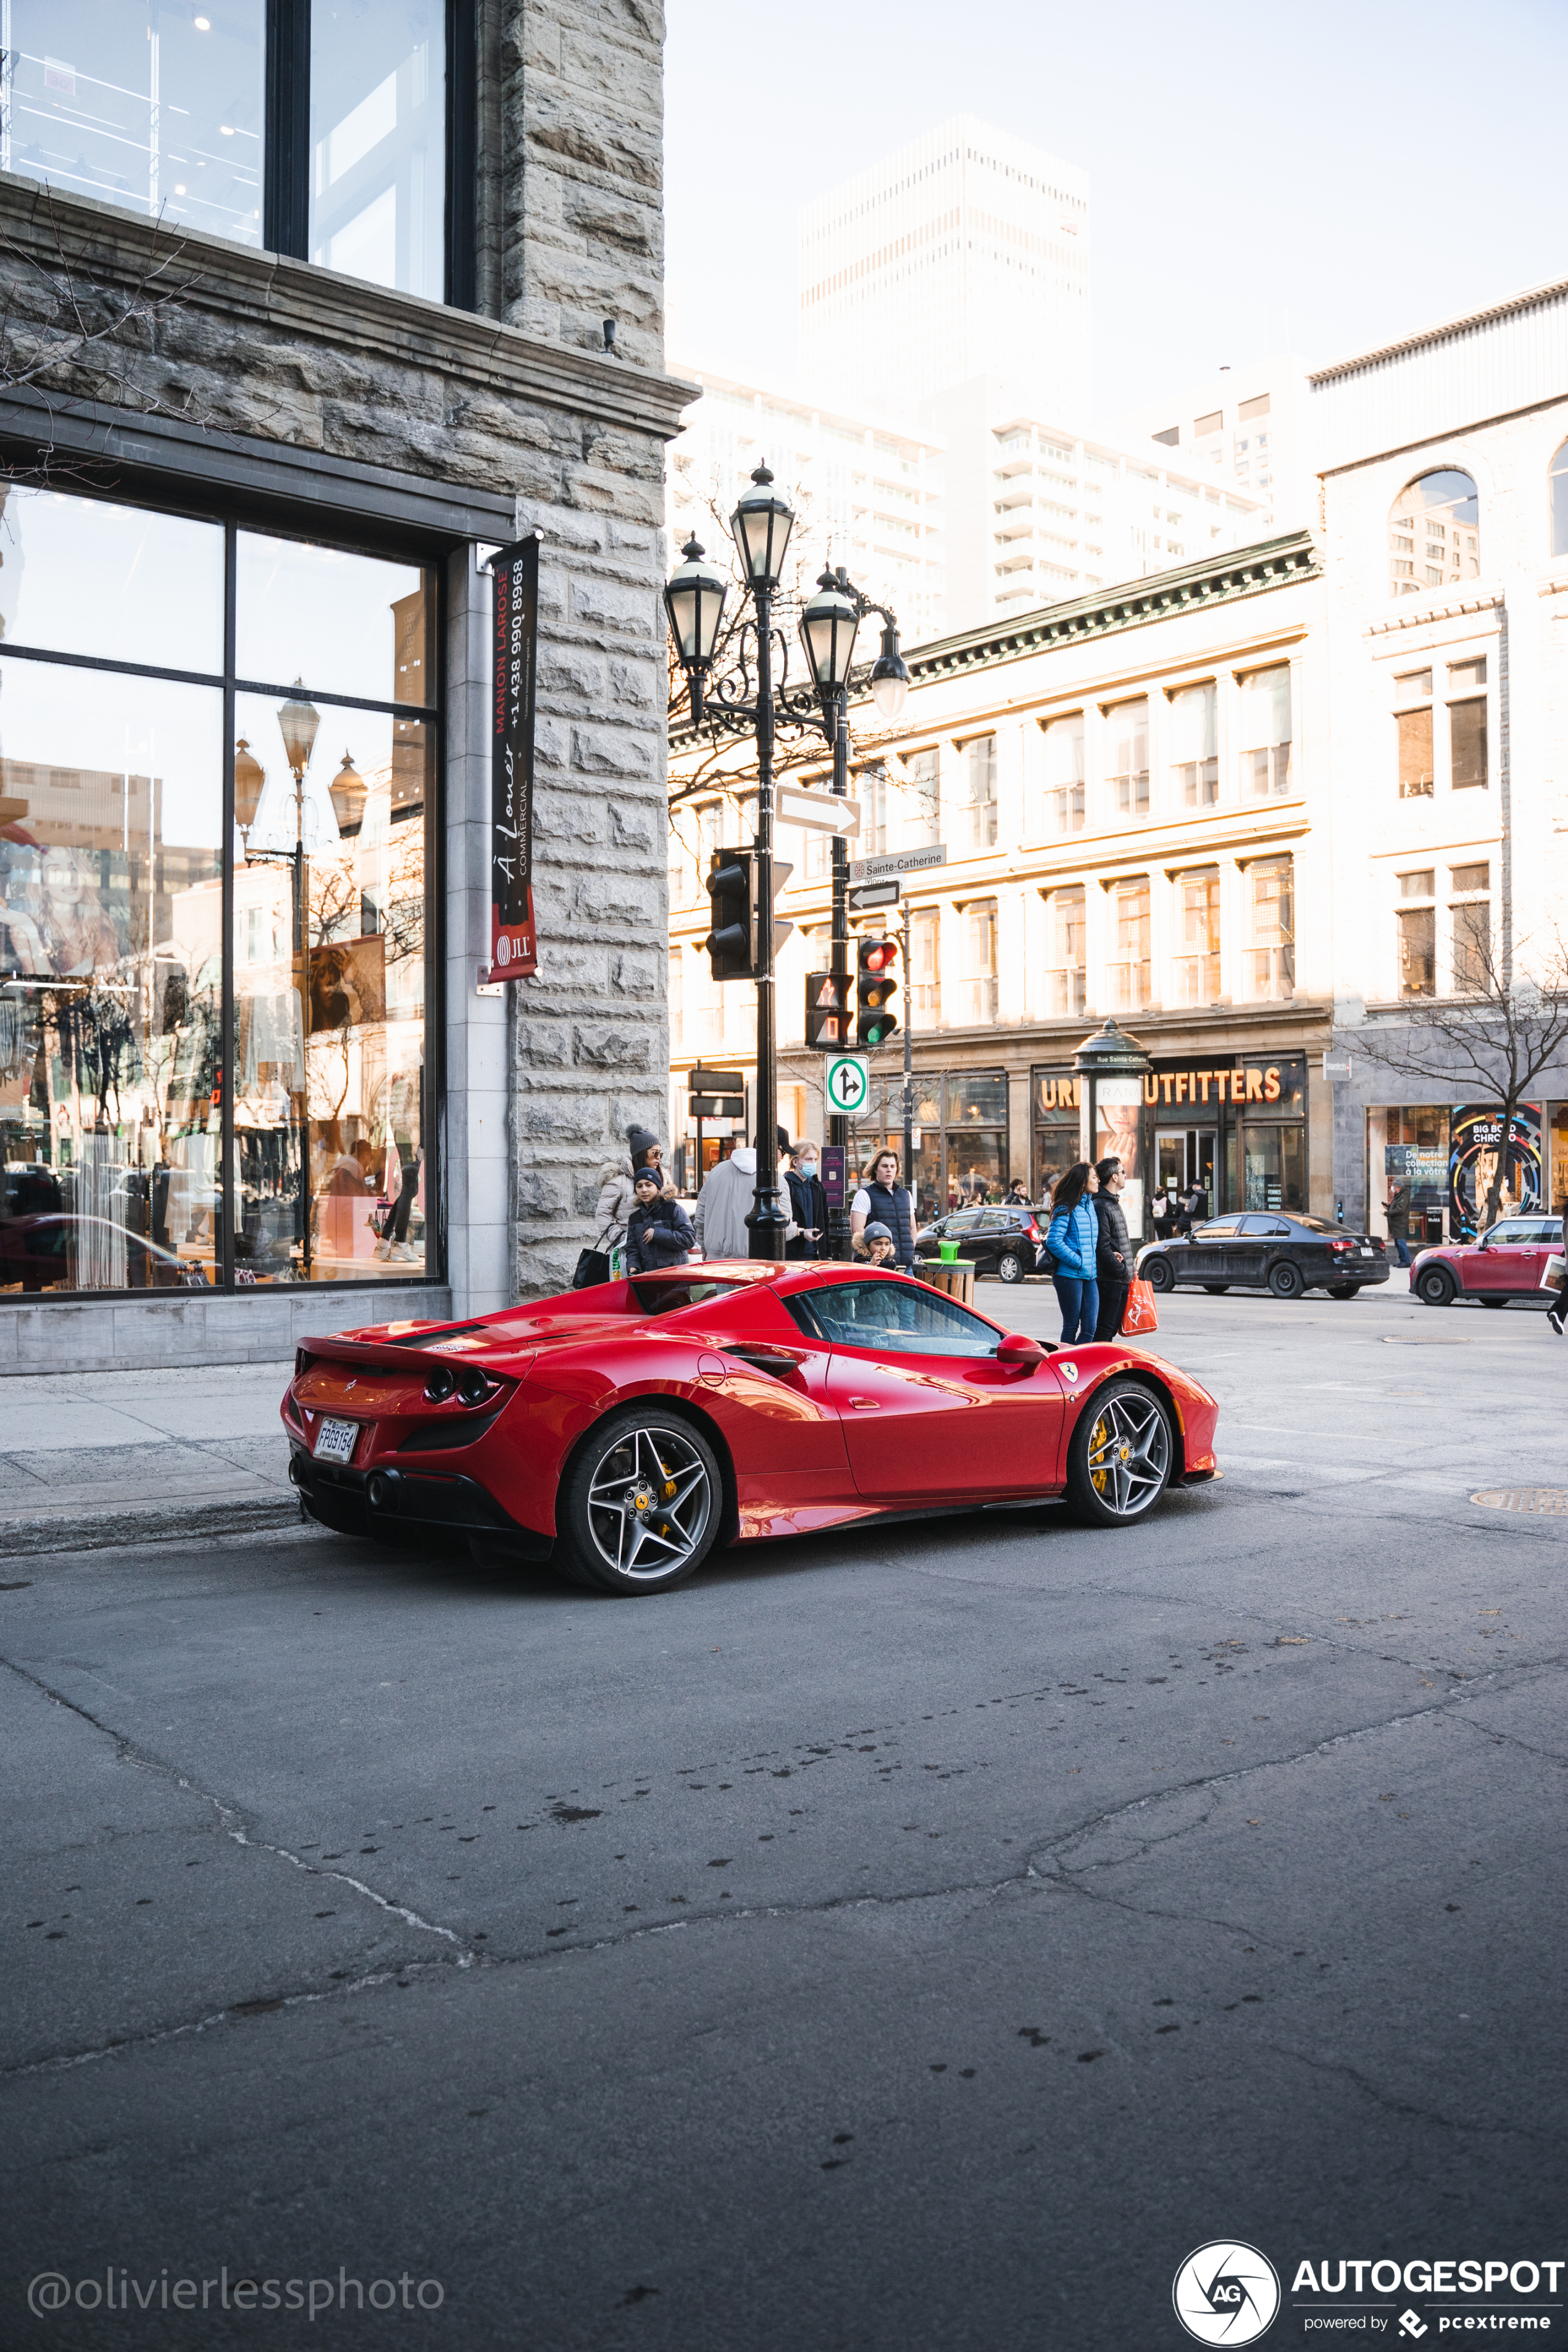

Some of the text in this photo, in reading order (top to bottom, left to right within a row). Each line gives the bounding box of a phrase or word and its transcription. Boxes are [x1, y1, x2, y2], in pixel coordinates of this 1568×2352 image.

[511, 559, 523, 728] +1 438 990 8968
[496, 656, 506, 734] MANON
[519, 780, 527, 876] COMMERCIAL
[866, 854, 941, 875] Sainte-Catherine
[1327, 1062, 1346, 1071] swatch
[1145, 1067, 1280, 1107] UTFITTERS
[1474, 1124, 1516, 1133] BIG BOD
[1474, 1133, 1516, 1143] CHROO
[1406, 1150, 1417, 1159] De
[1406, 1159, 1448, 1167] collection
[1406, 1167, 1447, 1175] à la vôtre
[318, 1427, 354, 1453] FPG9154
